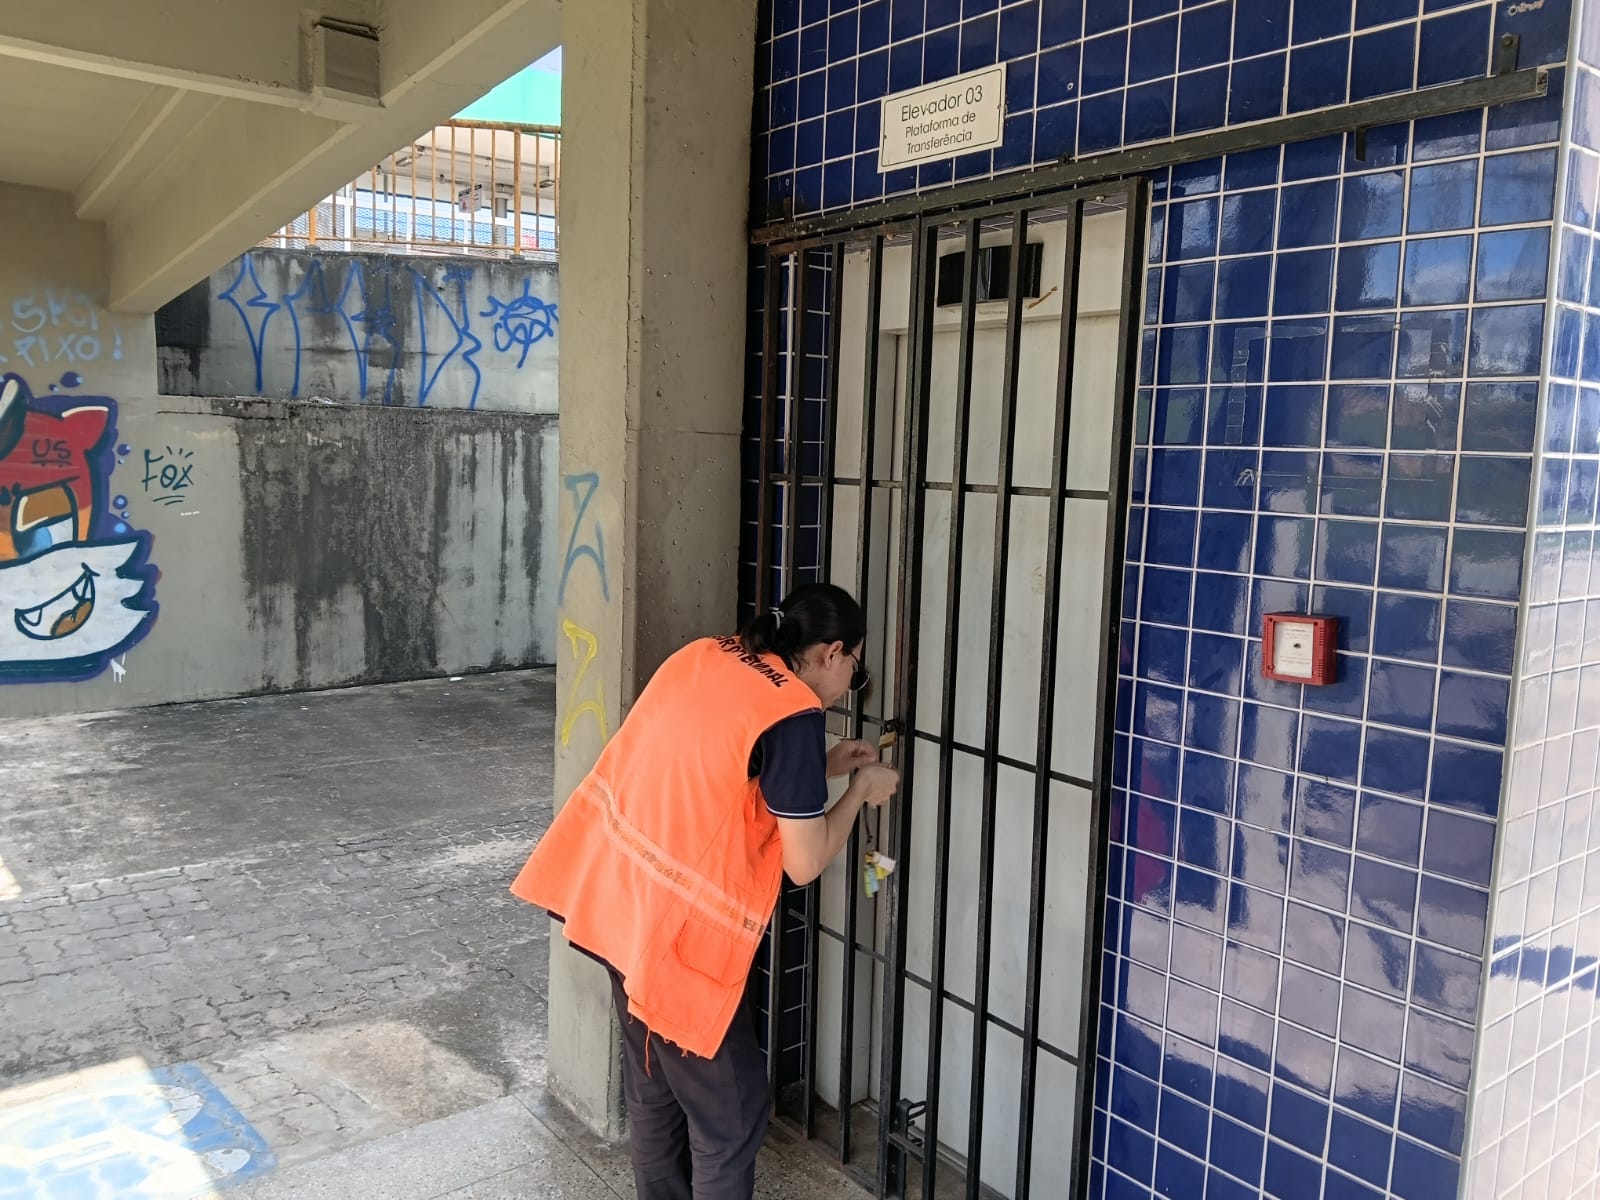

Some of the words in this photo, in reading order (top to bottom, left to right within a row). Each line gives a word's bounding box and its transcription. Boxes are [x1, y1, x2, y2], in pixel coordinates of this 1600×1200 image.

[901, 93, 963, 122] Elevador
[965, 84, 983, 105] 03
[905, 115, 960, 138] Plataforma
[961, 111, 977, 124] de
[907, 129, 973, 155] Transferência
[32, 438, 72, 460] US
